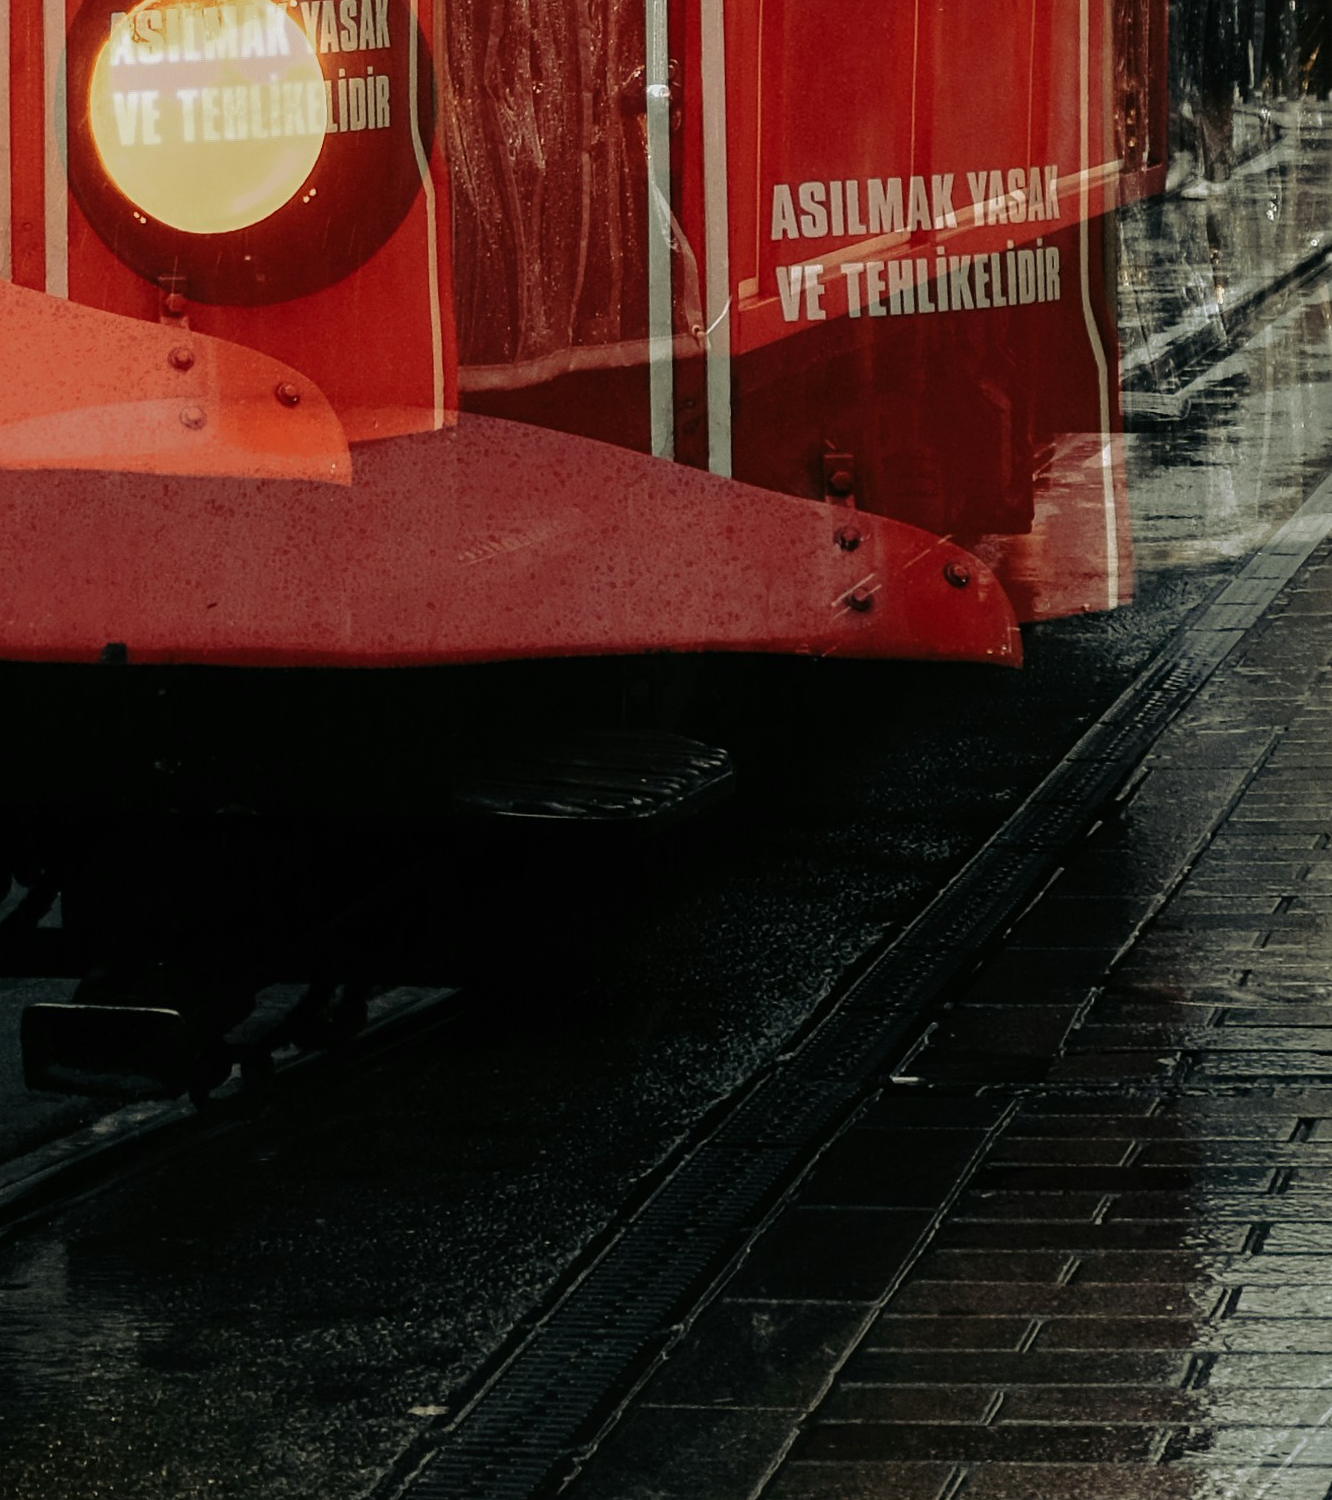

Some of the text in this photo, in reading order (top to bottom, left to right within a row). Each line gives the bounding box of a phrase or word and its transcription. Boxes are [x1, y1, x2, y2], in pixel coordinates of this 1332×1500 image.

[110, 2, 290, 66] ASILMAK
[113, 65, 391, 147] VE TEHLİKELİDİR
[771, 165, 1061, 241] ASILMAK YASAK
[776, 238, 1061, 322] VE TEHLİKELİDİR
